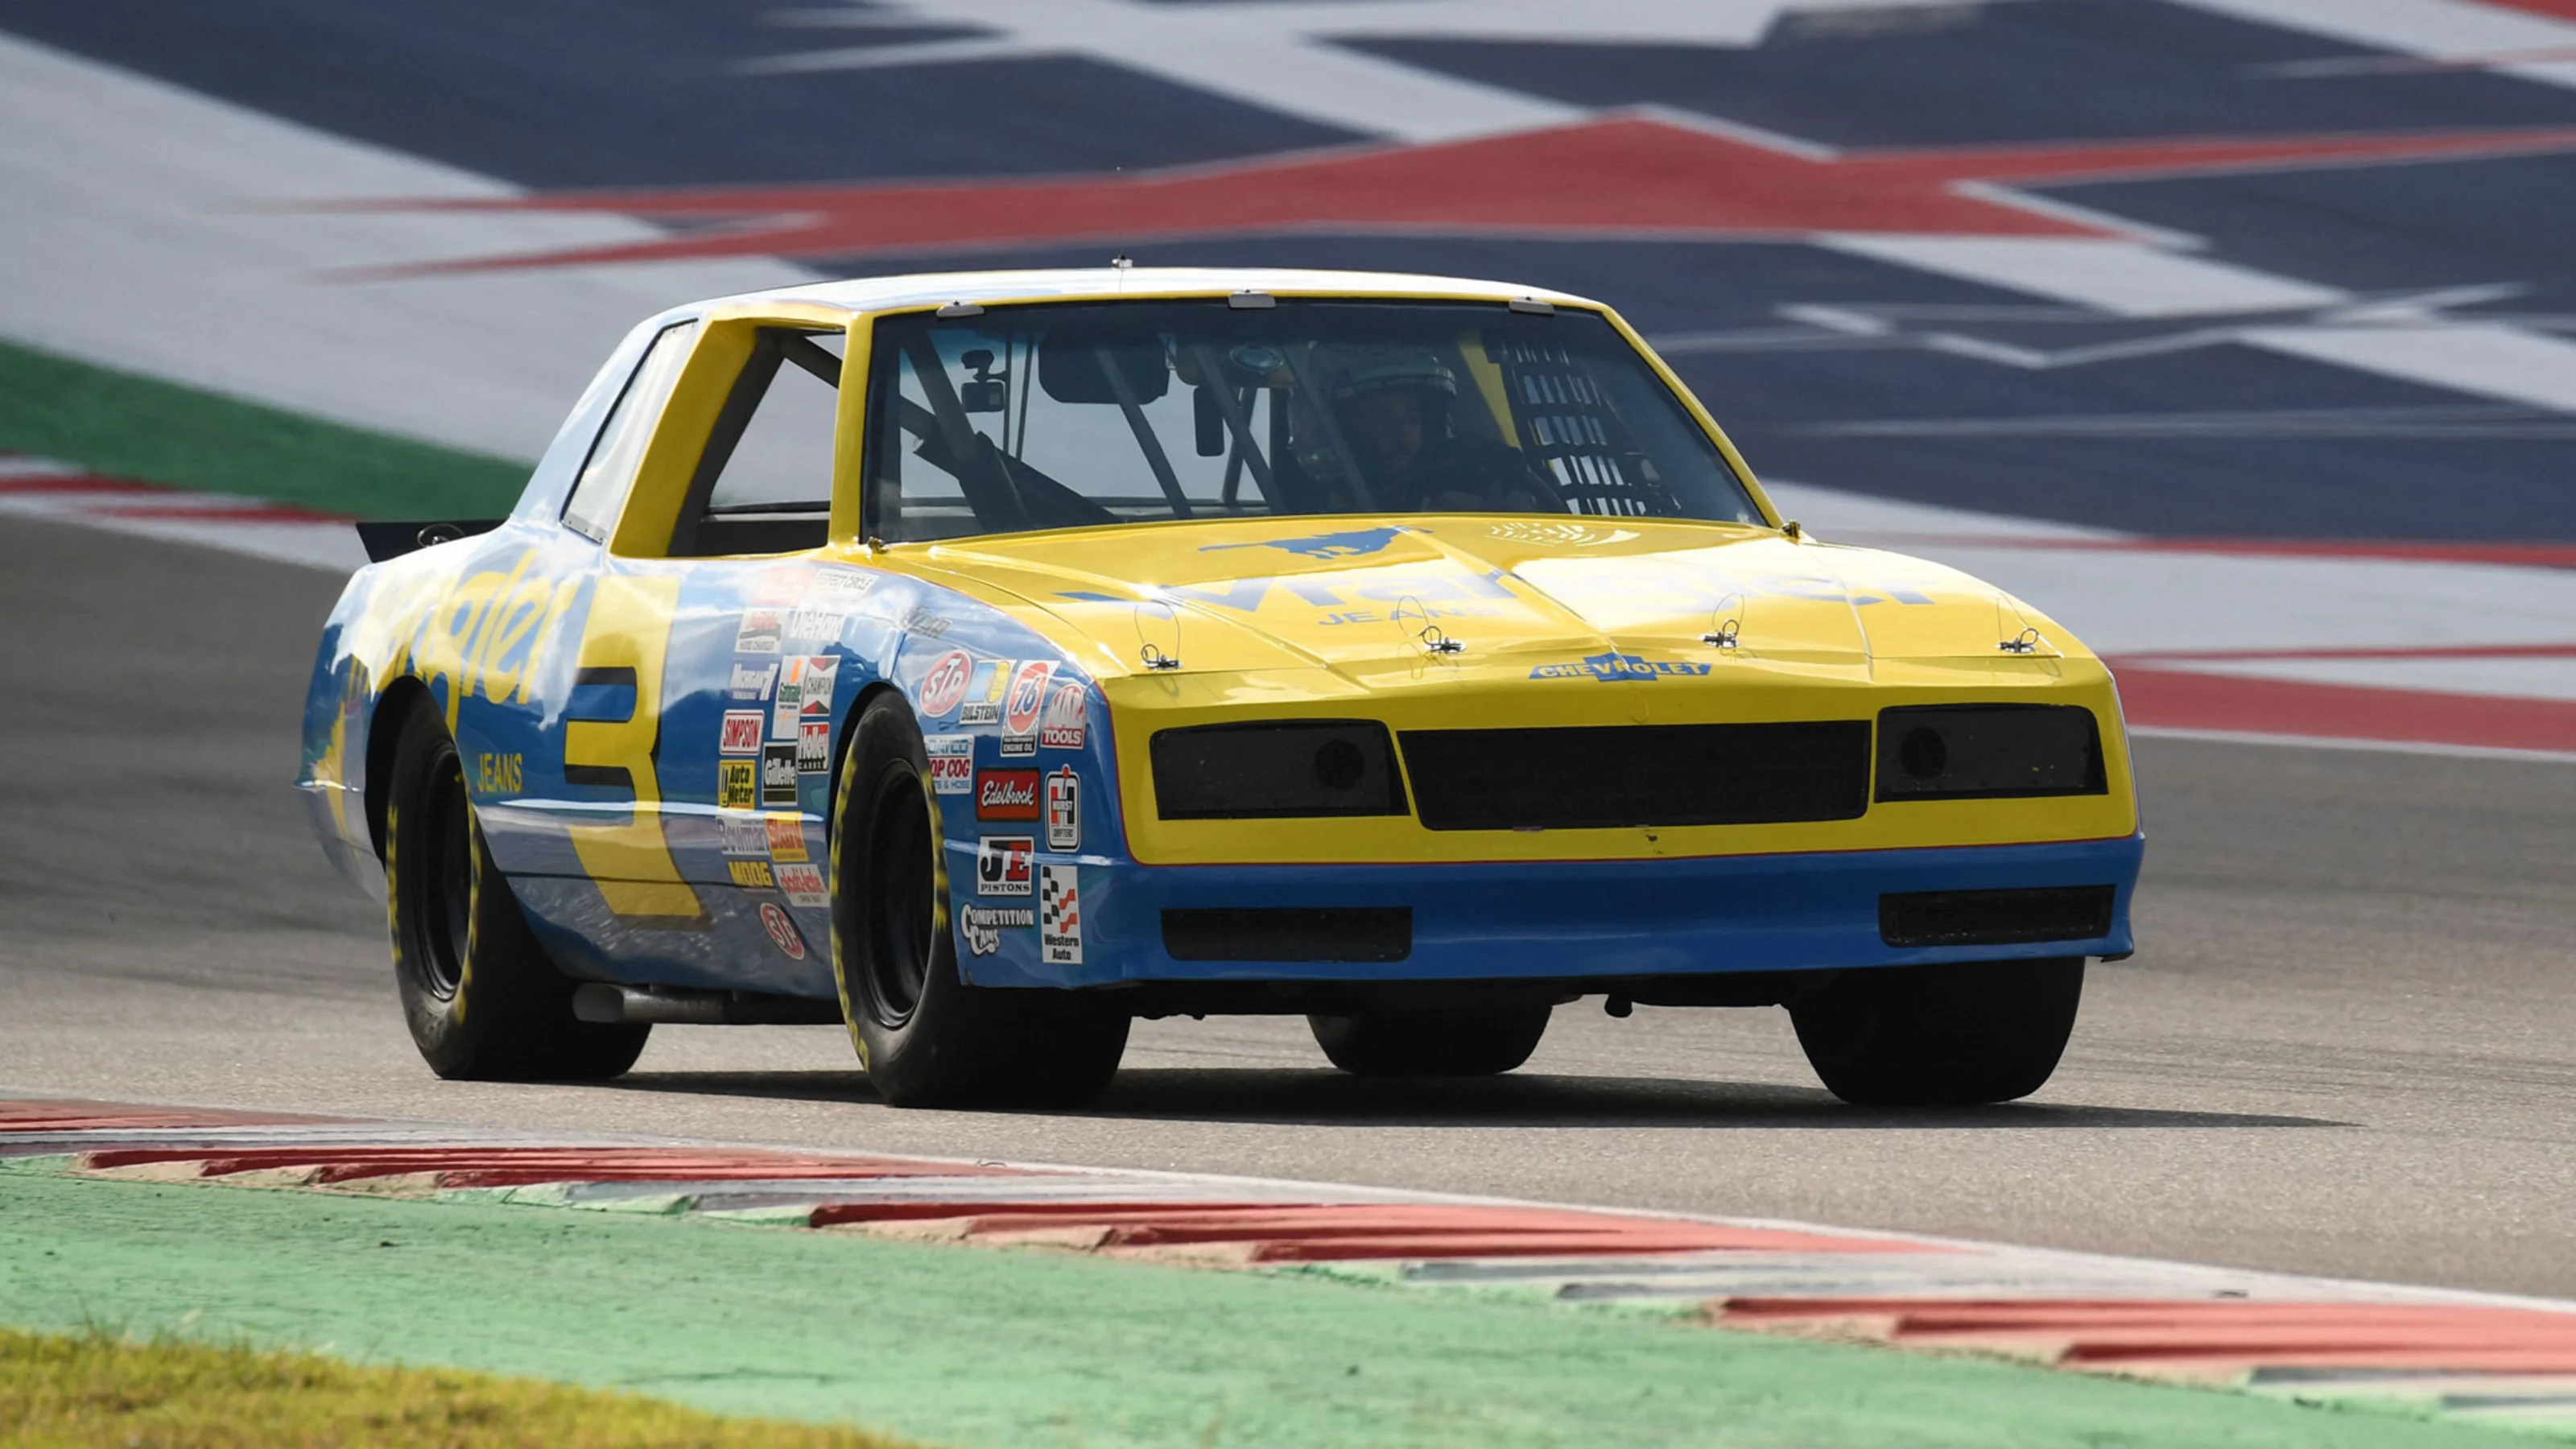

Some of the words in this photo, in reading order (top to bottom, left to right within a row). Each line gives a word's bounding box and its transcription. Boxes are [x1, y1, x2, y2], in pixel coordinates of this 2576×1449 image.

[1318, 606, 1506, 626] JEANS
[925, 658, 964, 705] STP
[1538, 660, 1703, 677] CHEVROLET
[1011, 675, 1041, 715] 76
[961, 704, 1001, 720] BILSTEIN
[564, 576, 702, 916] 3
[723, 719, 761, 747] SIMPSON
[1044, 729, 1082, 745] TOOLS
[798, 726, 828, 770] Holley
[1003, 743, 1023, 753] ENGINE
[477, 753, 522, 794] JEANS
[729, 765, 750, 784] Auto
[766, 758, 795, 786] Gillette
[929, 759, 945, 778] OP
[947, 758, 971, 778] COG
[729, 785, 753, 803] Meter
[981, 779, 1034, 807] Edelbrock
[1052, 800, 1073, 811] HURST
[717, 818, 769, 852] Bowman
[728, 861, 774, 887] MOOG
[980, 840, 1032, 881] JE
[980, 883, 1030, 893] PISTONS
[767, 909, 799, 948] STP
[961, 903, 1034, 938] COMPETITION
[970, 926, 1001, 956] CAMS
[1044, 933, 1080, 947] Western
[1052, 947, 1072, 960] Auto
